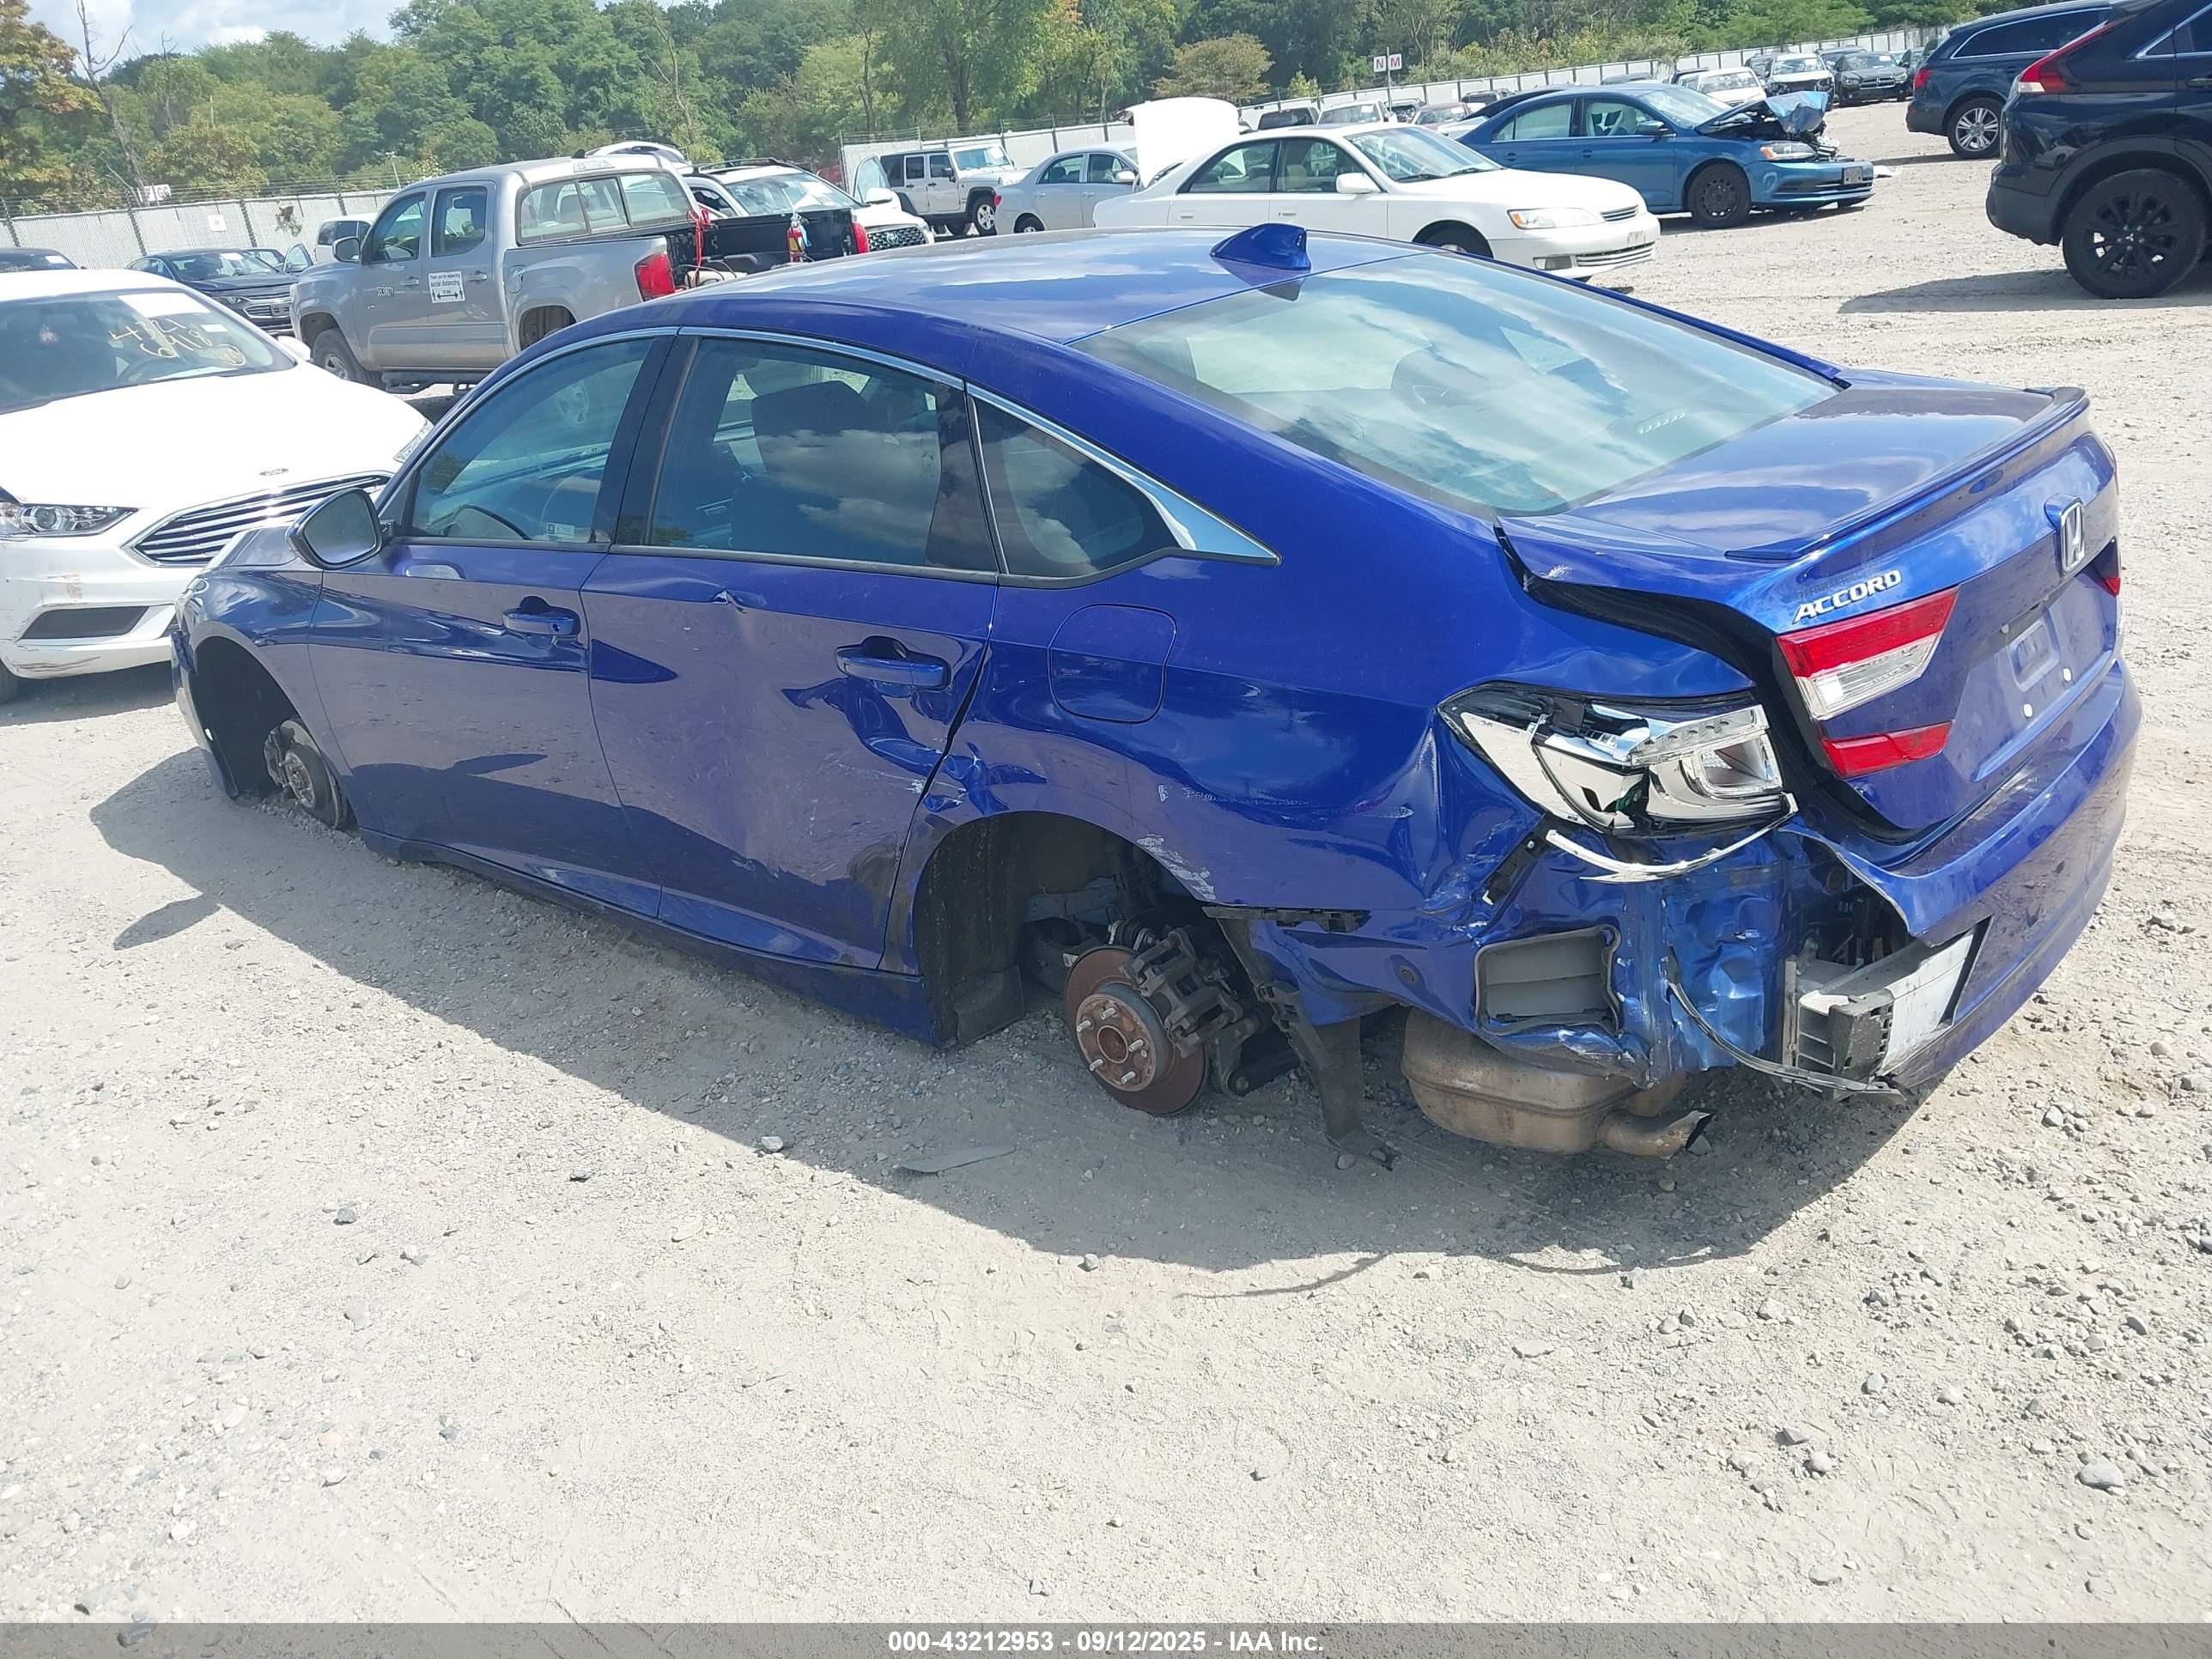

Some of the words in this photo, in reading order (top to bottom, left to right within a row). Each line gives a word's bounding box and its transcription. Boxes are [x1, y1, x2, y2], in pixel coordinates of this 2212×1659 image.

[1376, 58, 1383, 69] N
[1390, 57, 1401, 68] M
[377, 286, 395, 296] SECURITY
[1792, 569, 1902, 624] ACCORD
